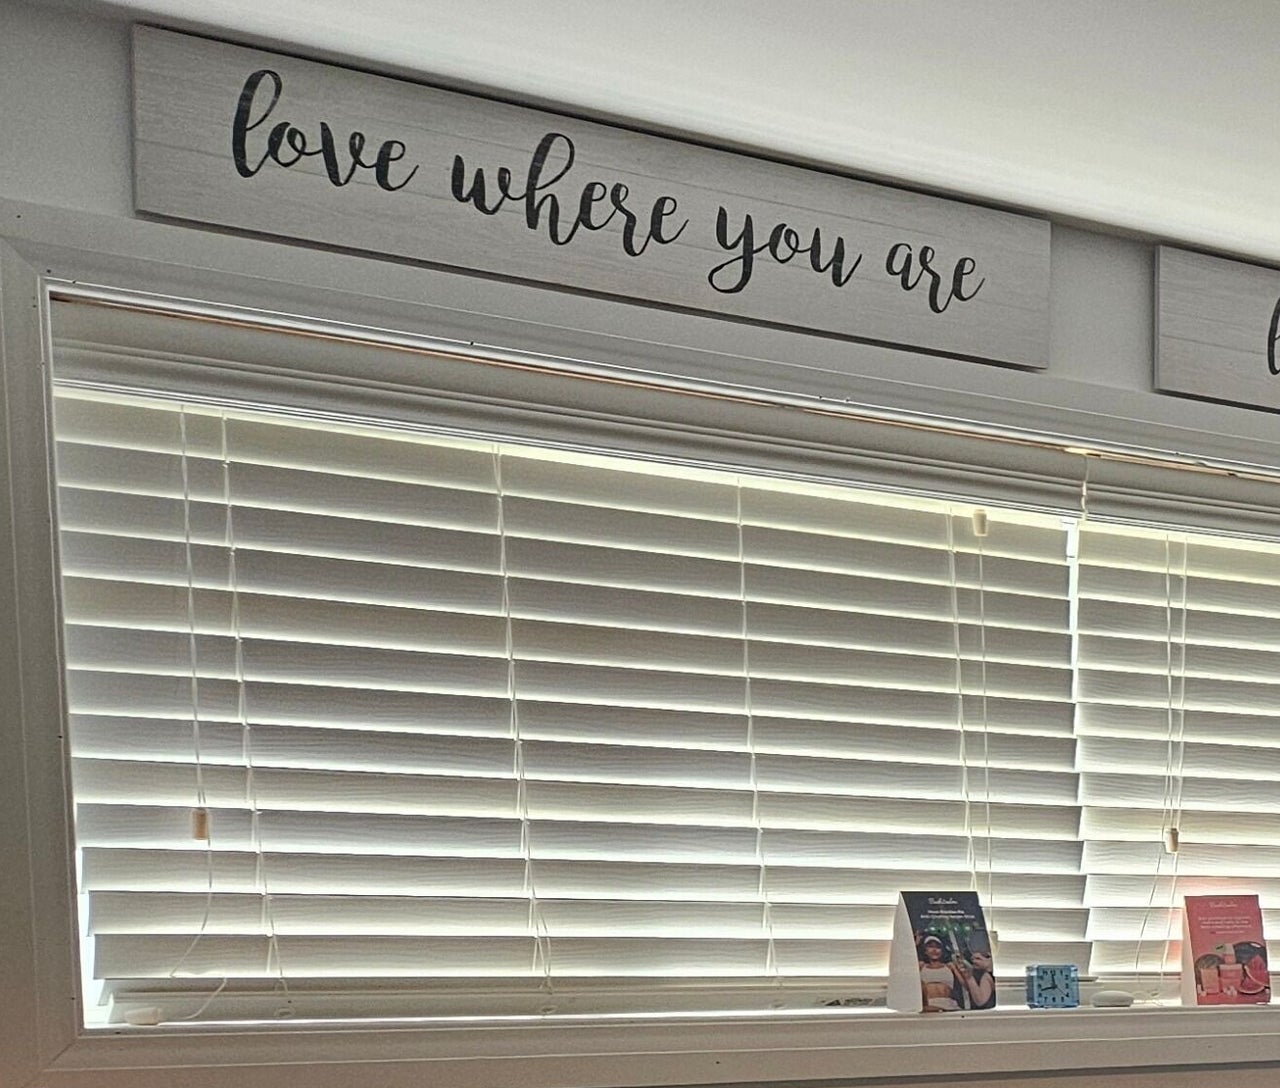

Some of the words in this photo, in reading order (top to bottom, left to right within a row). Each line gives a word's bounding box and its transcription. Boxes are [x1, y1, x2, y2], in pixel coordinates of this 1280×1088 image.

[231, 68, 421, 193] love
[450, 131, 692, 258] where
[707, 201, 865, 294] you
[885, 238, 987, 314] are
